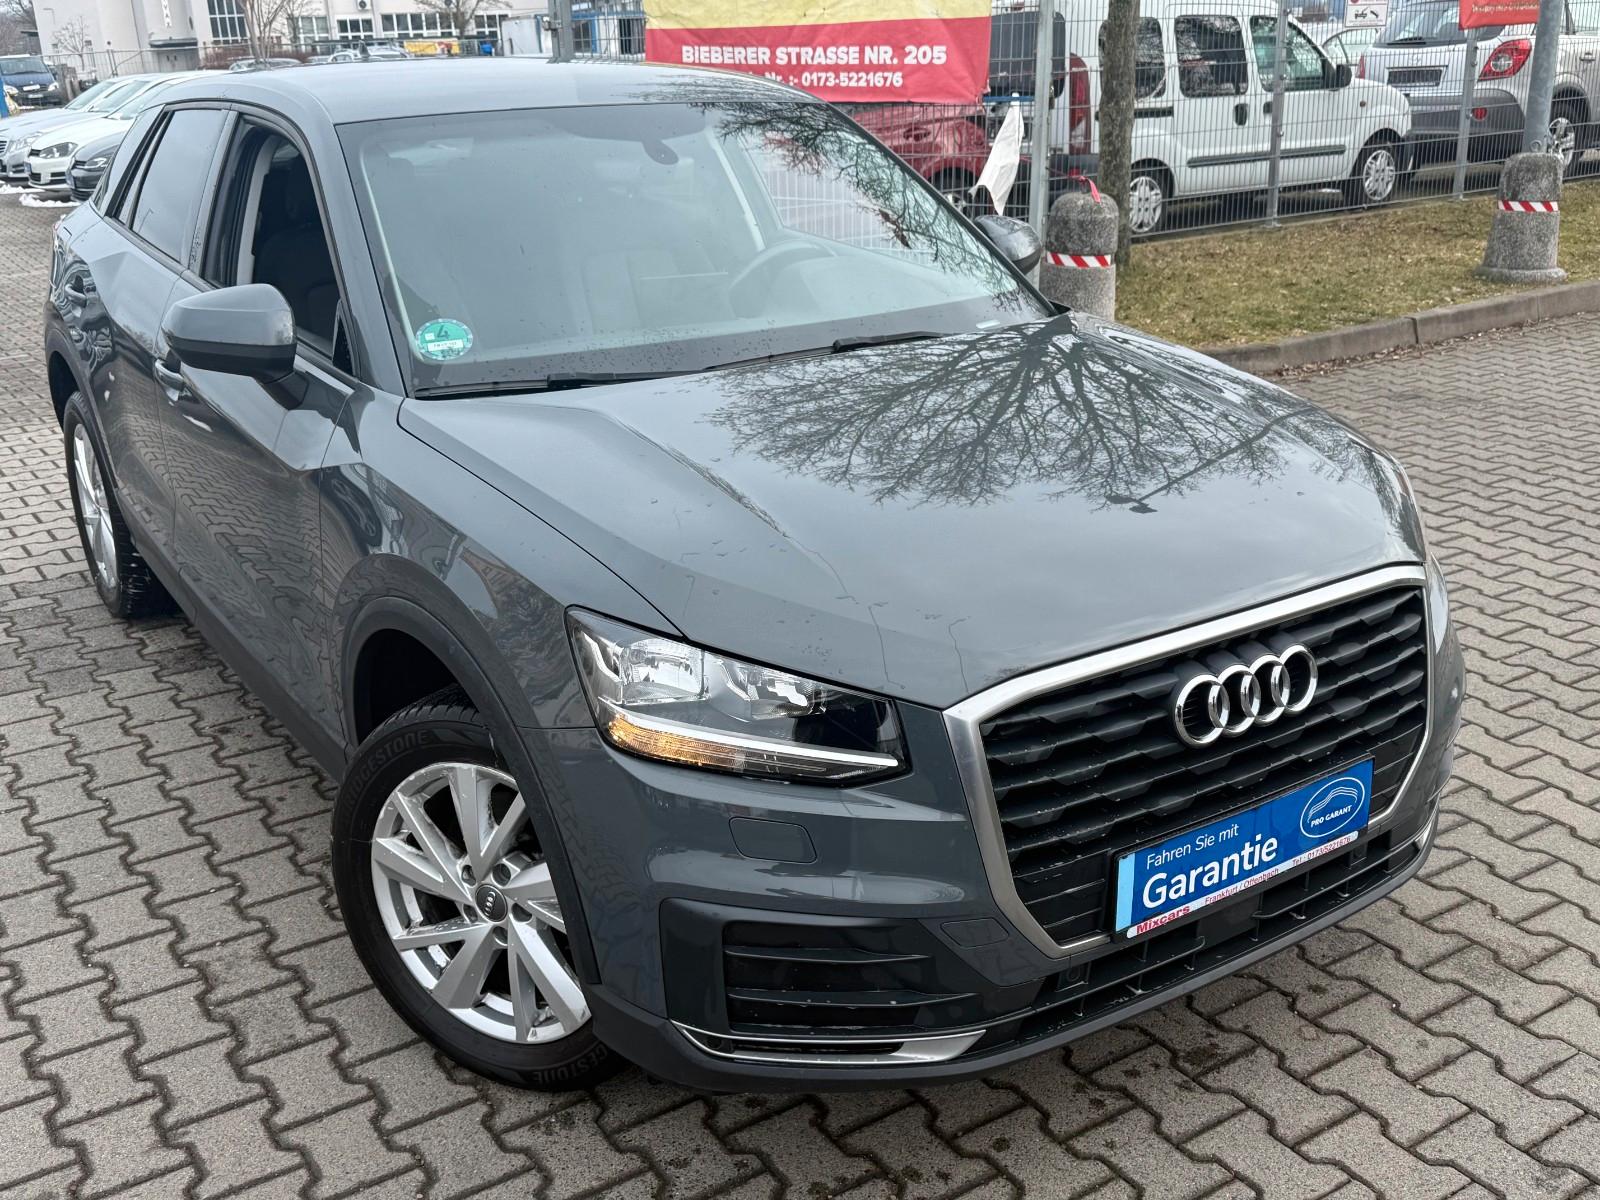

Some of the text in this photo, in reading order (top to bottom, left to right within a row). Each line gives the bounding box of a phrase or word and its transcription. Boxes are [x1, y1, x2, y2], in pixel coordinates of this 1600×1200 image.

[682, 45, 947, 65] BIEBERER STRASSE NR. 205
[801, 72, 903, 88] 0173-5221676
[1310, 805, 1352, 828] PRO GARANT
[1146, 823, 1239, 870] Fahren Sie mit
[1142, 834, 1278, 908] Garantie
[1136, 905, 1190, 935] Mixcars
[1205, 885, 1238, 904] Frankfurt
